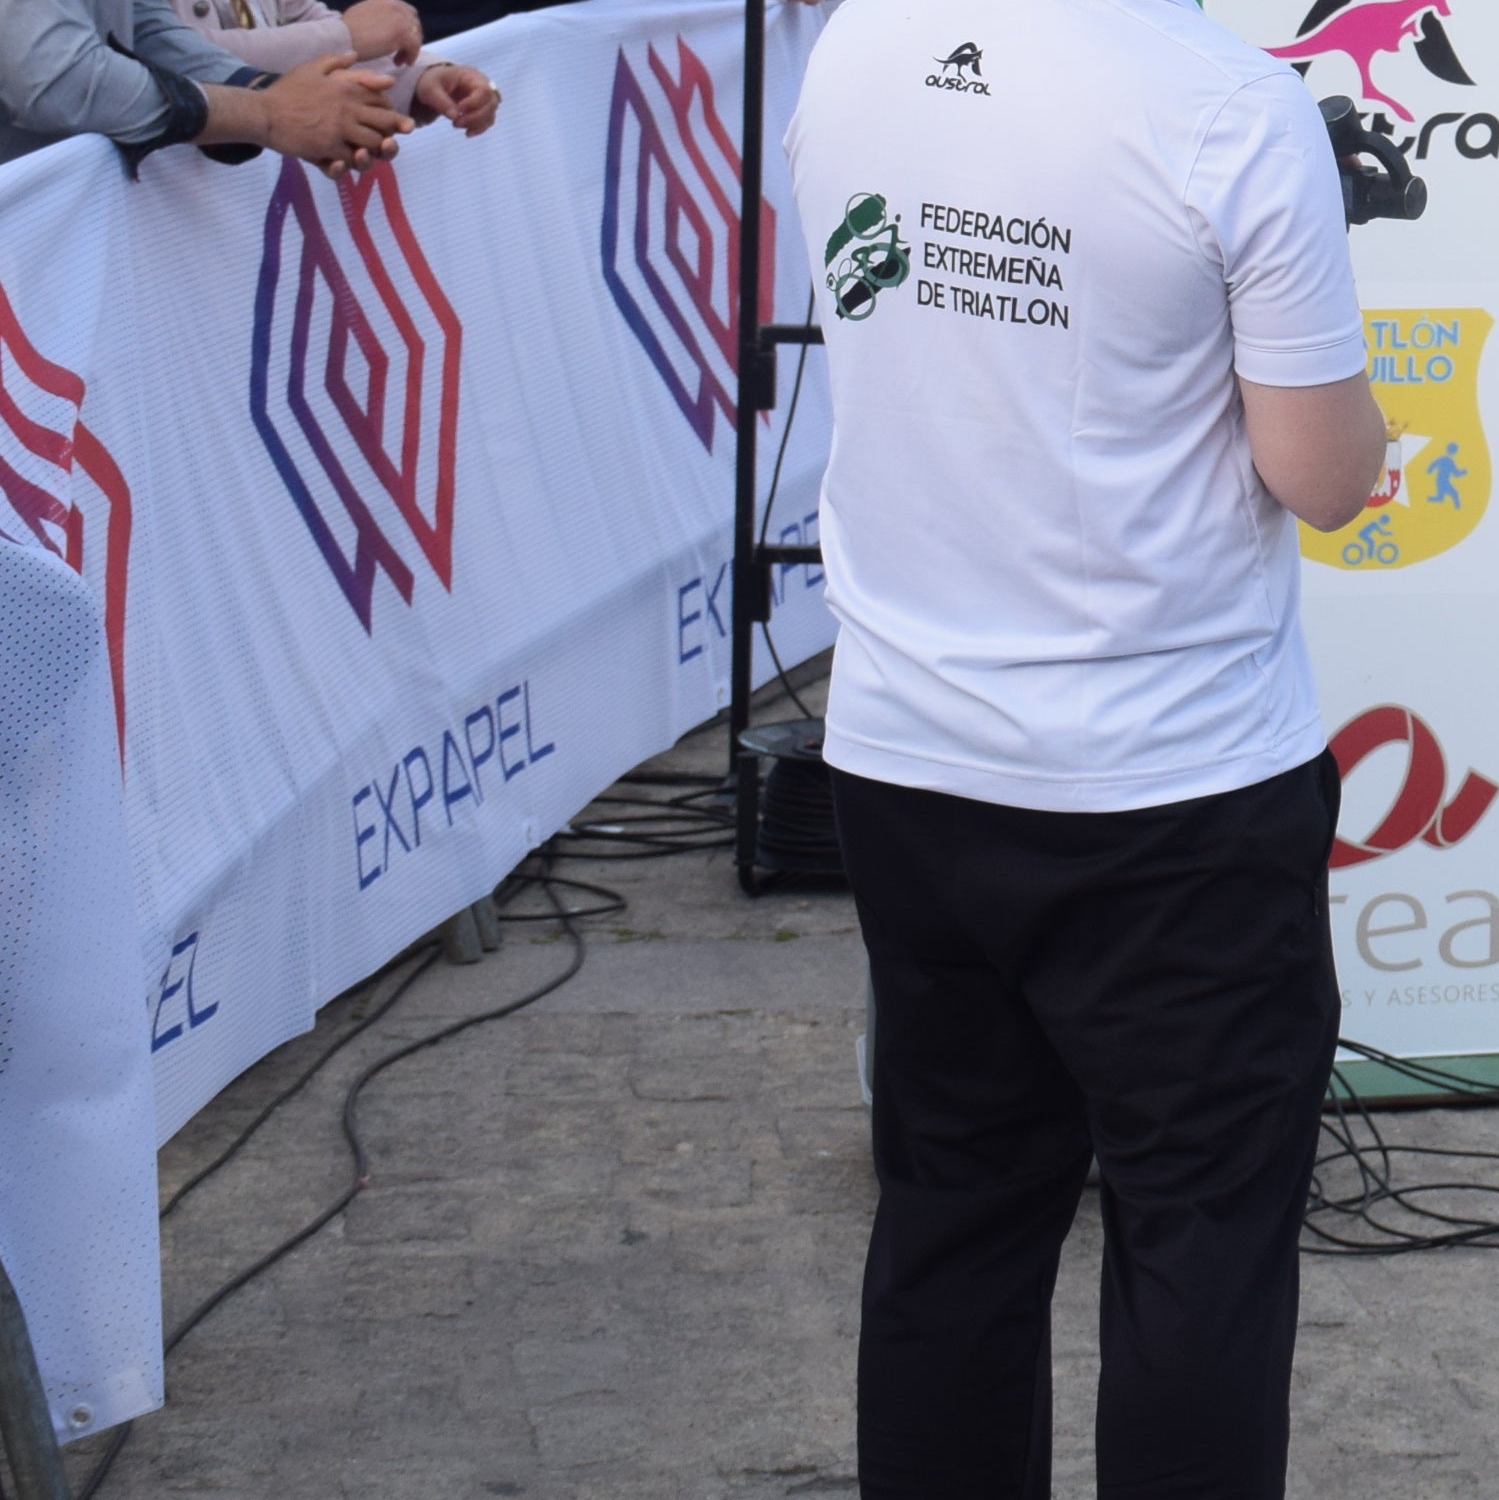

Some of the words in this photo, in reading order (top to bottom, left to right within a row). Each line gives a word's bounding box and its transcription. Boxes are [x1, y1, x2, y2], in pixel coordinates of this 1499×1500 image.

[925, 74, 991, 96] austral
[920, 202, 1072, 254] FEDERACIÓN
[924, 242, 1064, 291] EXTREMEÑA
[917, 279, 945, 309] DE
[950, 286, 1069, 330] TRIATLON
[1368, 316, 1461, 350] TLÓN
[1369, 355, 1454, 384] JILLO
[352, 680, 556, 893] EXPAPEL
[1364, 988, 1375, 1008] Y
